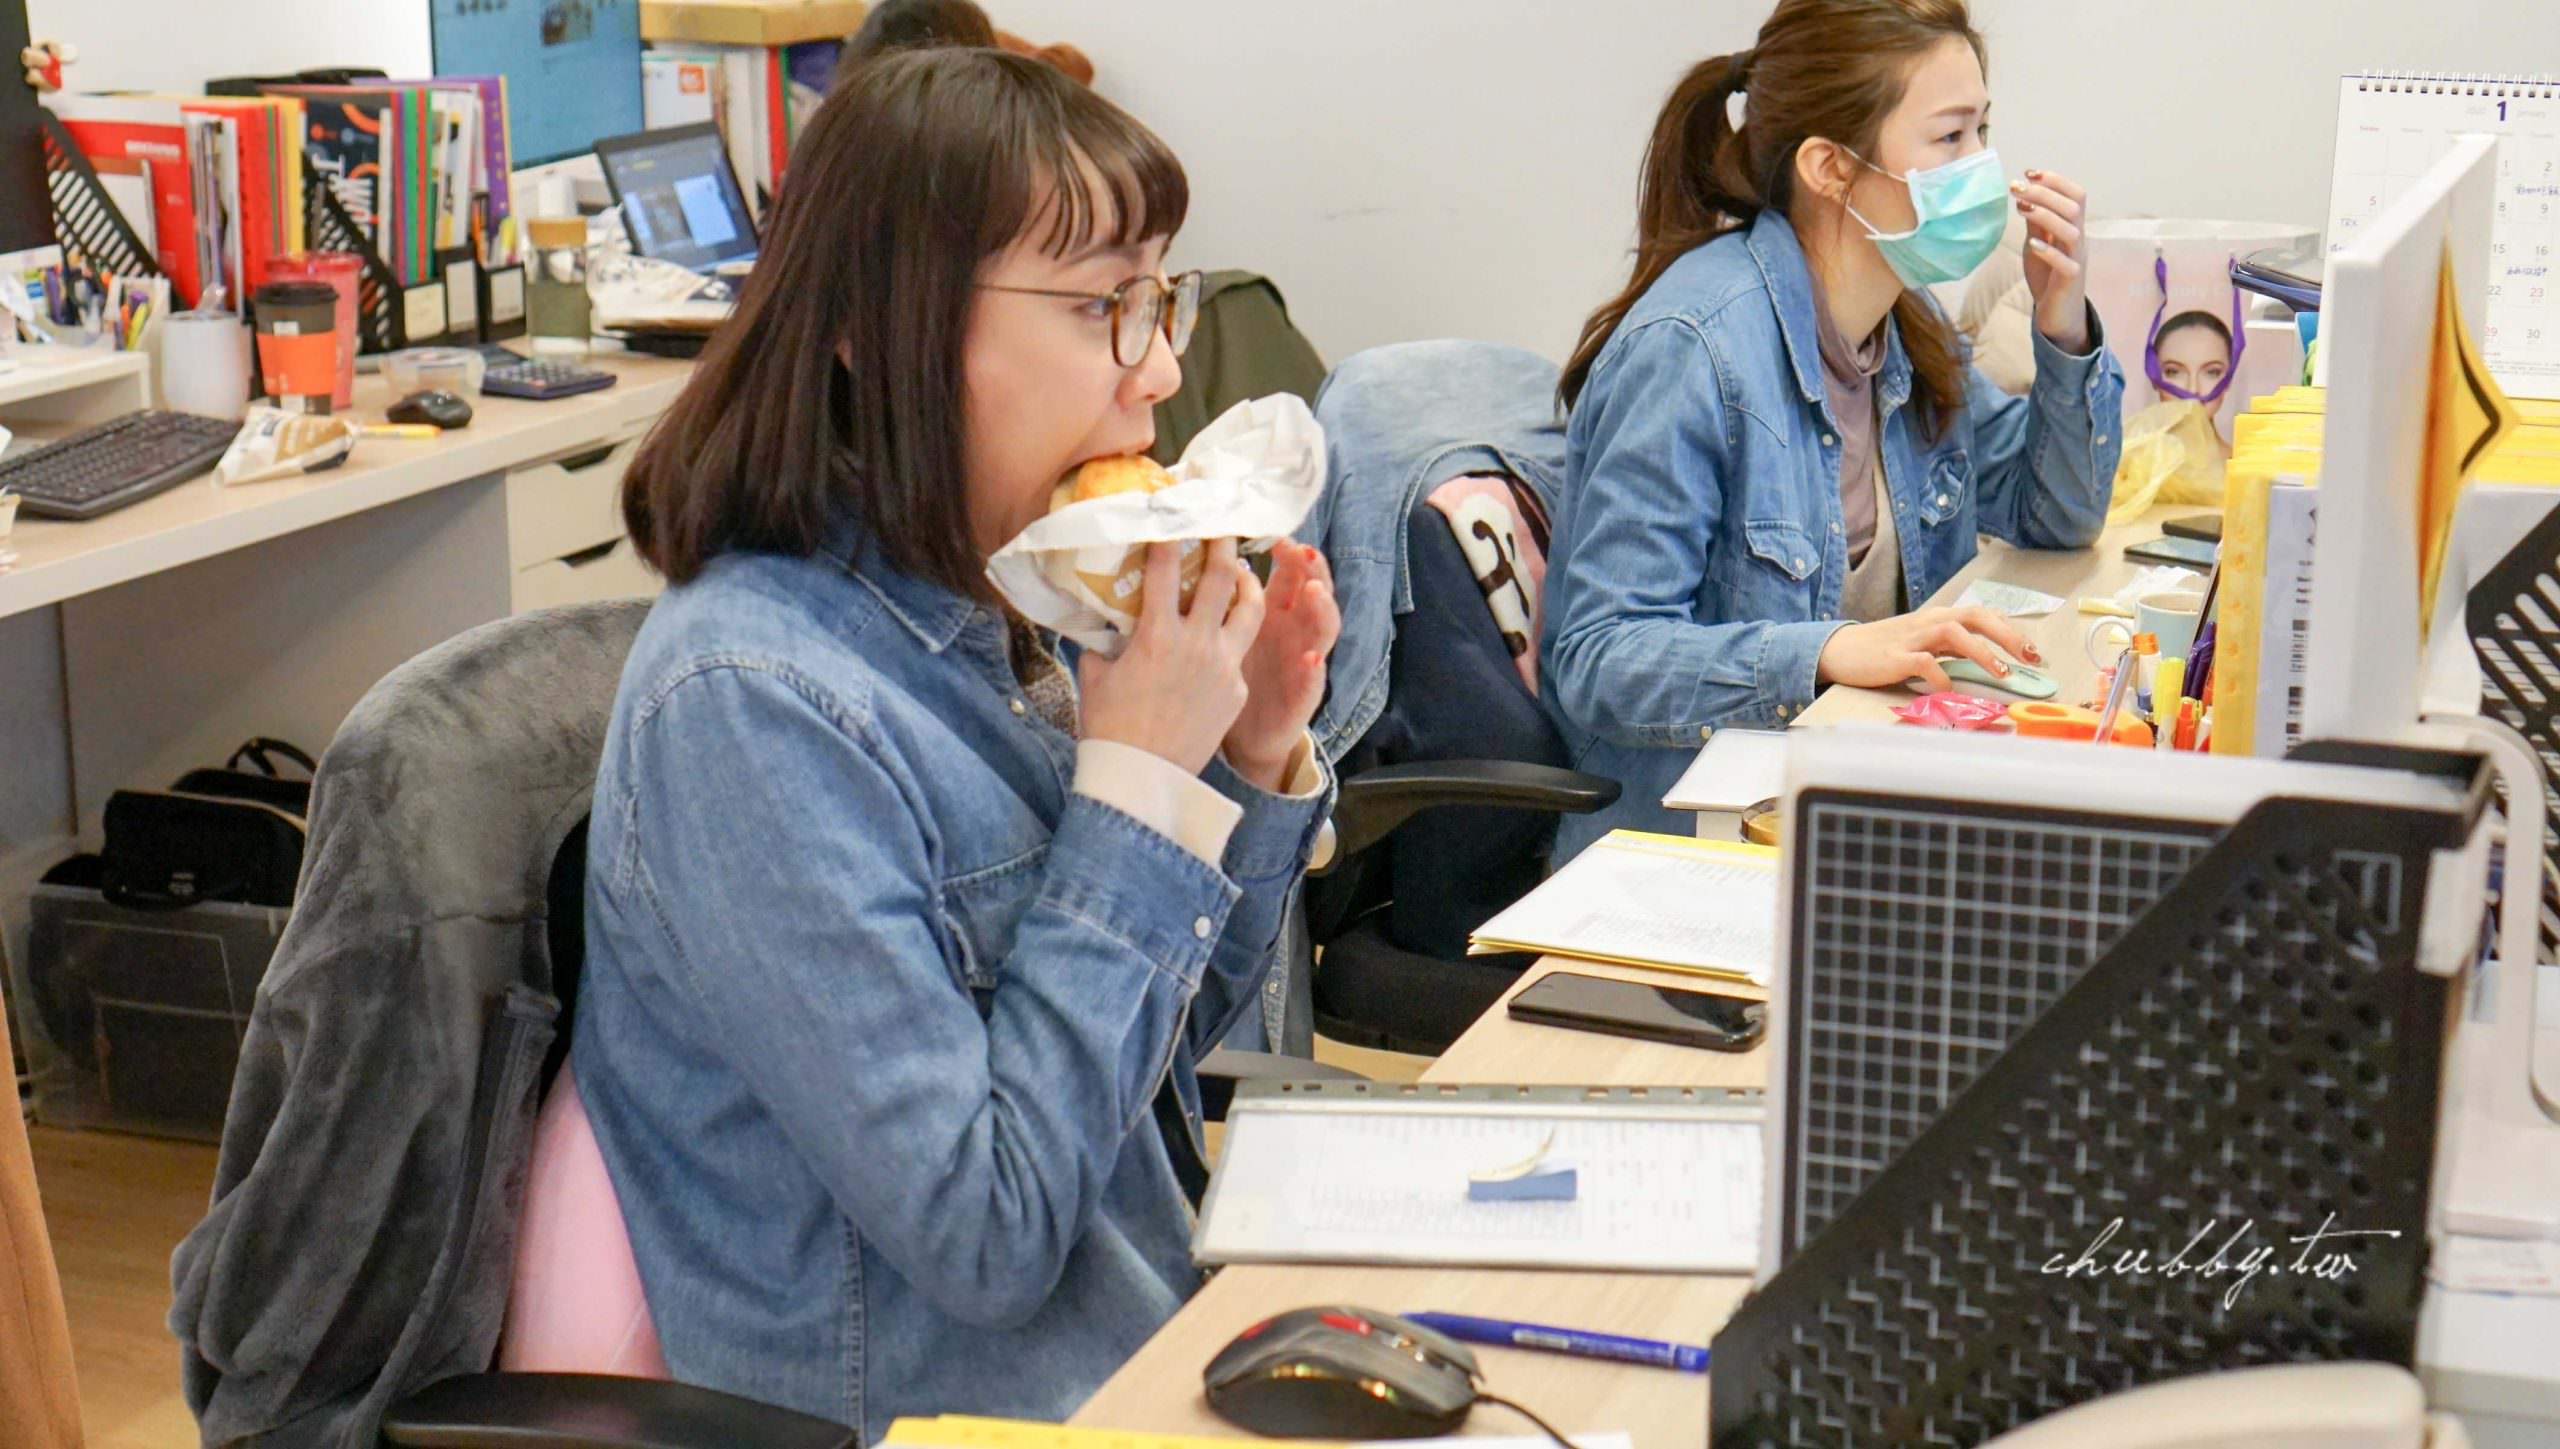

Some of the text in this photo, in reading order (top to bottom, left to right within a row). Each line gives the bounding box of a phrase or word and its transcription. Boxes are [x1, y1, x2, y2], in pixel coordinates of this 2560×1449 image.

[2496, 101, 2507, 122] 1
[2543, 161, 2553, 173] 2
[2369, 196, 2377, 206] 5
[2499, 201, 2549, 214] 8 9
[2493, 243, 2549, 256] 15 16
[2487, 285, 2544, 298] 22 23
[2526, 328, 2541, 339] 30
